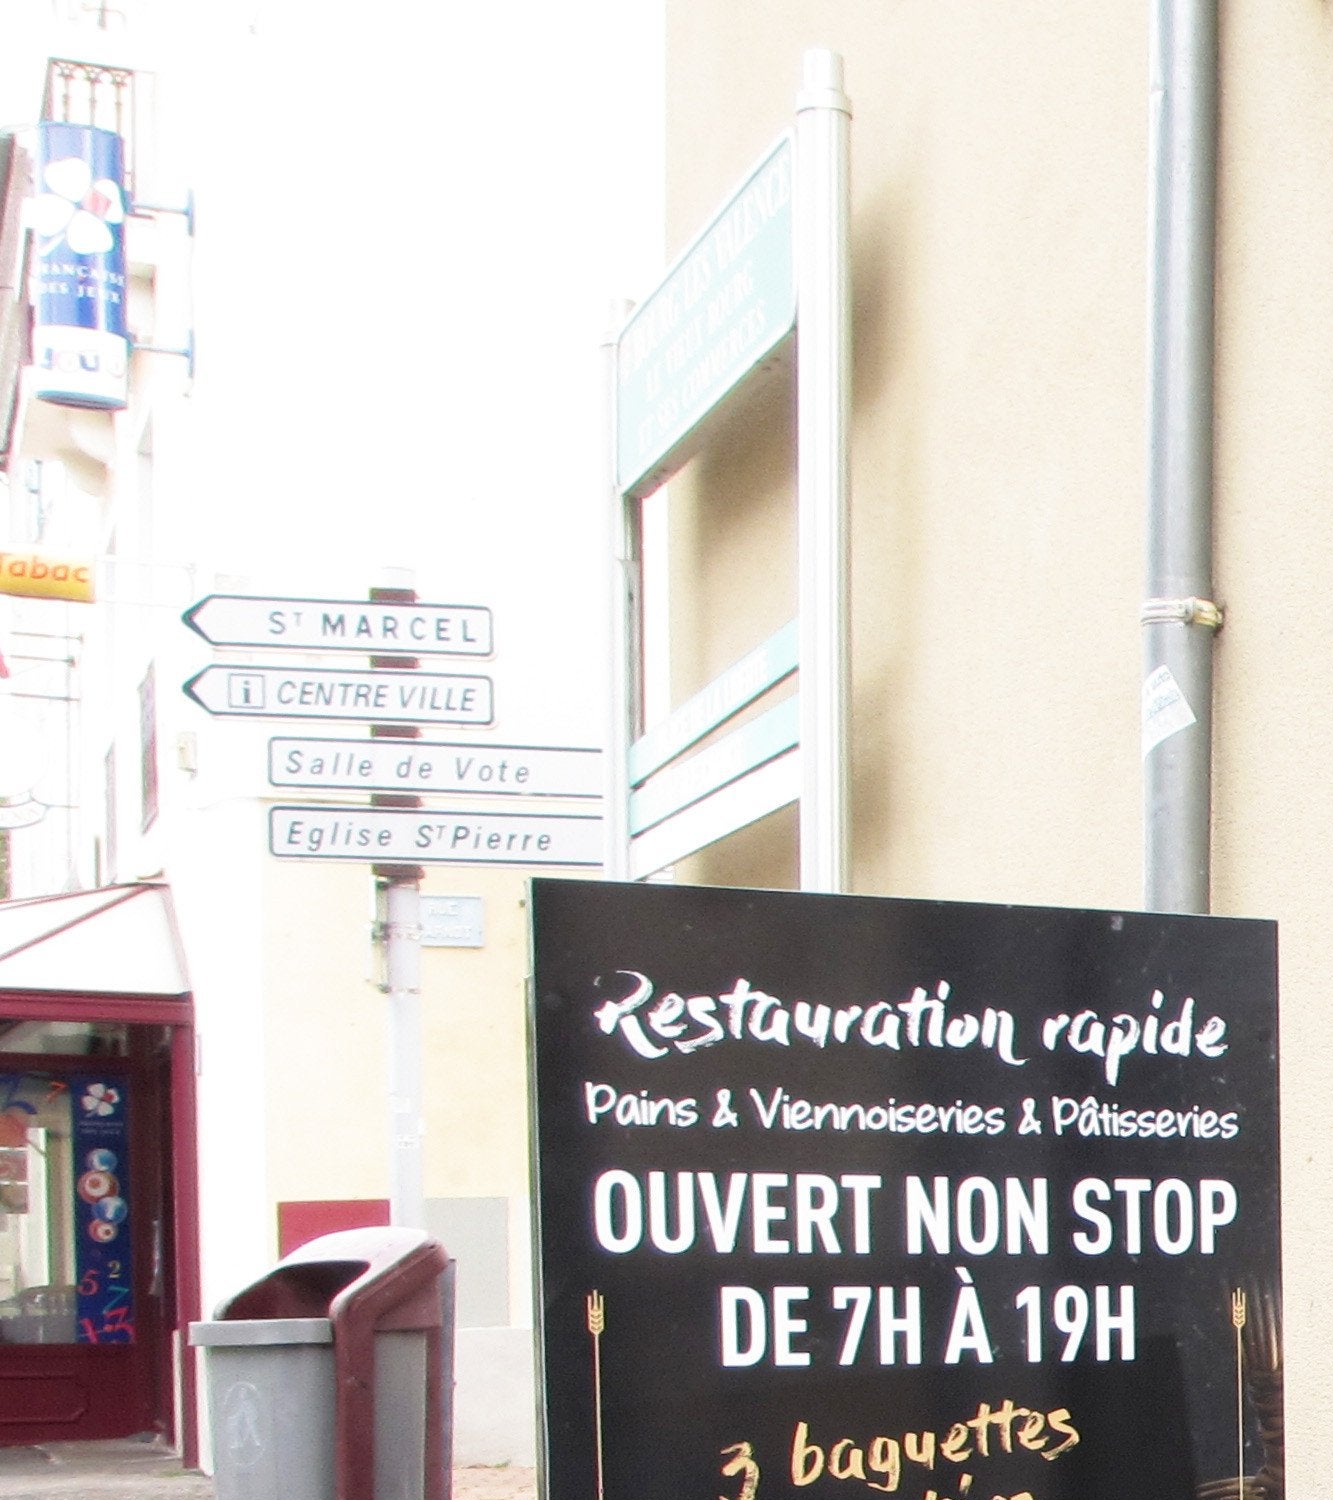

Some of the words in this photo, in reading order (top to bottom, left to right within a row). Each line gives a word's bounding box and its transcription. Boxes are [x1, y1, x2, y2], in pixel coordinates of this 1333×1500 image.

[322, 613, 477, 643] MARCEL
[277, 681, 388, 708] CENTRE
[399, 685, 477, 712] VILLE
[286, 750, 373, 777] Salle
[397, 756, 433, 779] de
[456, 757, 531, 783] Vote
[287, 820, 392, 851] Eglise
[451, 826, 552, 851] Pierre
[595, 970, 1028, 1065] Restauration
[1042, 990, 1228, 1085] rapide
[586, 1083, 698, 1128] Pains
[712, 1090, 738, 1124] &
[750, 1087, 1005, 1136] Viennoiseries
[1018, 1099, 1041, 1134] &
[1053, 1096, 1238, 1139] Pâtisseries
[596, 1169, 880, 1254] OUVERT
[905, 1176, 1049, 1256] NON
[1072, 1178, 1238, 1256] STOP
[720, 1286, 810, 1368] DE
[832, 1286, 922, 1366] 7H
[944, 1266, 993, 1364] À
[1016, 1285, 1136, 1363] 19H
[791, 1400, 1079, 1492] baguettes
